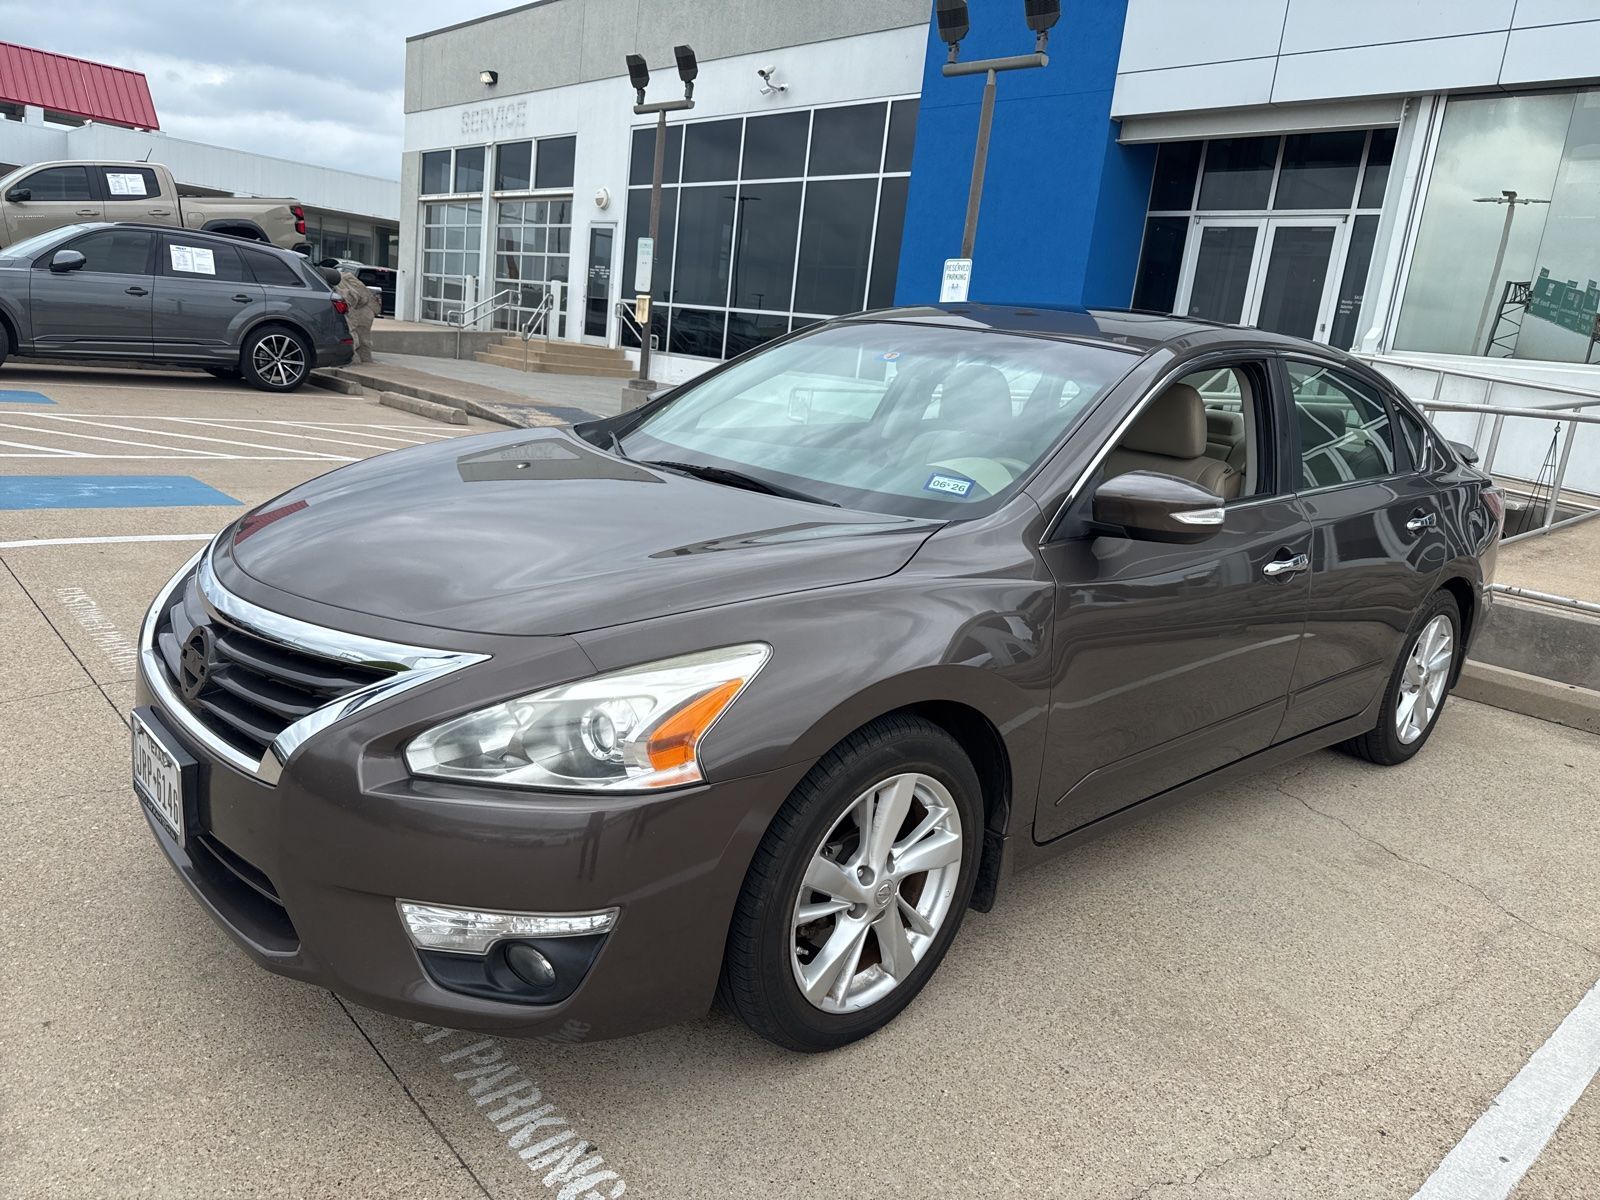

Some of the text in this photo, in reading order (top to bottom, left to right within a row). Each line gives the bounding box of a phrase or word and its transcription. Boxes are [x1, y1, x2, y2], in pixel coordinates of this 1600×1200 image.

[461, 101, 527, 134] SERVICE
[932, 480, 966, 492] 06 26
[440, 1038, 627, 1200] PARKING
